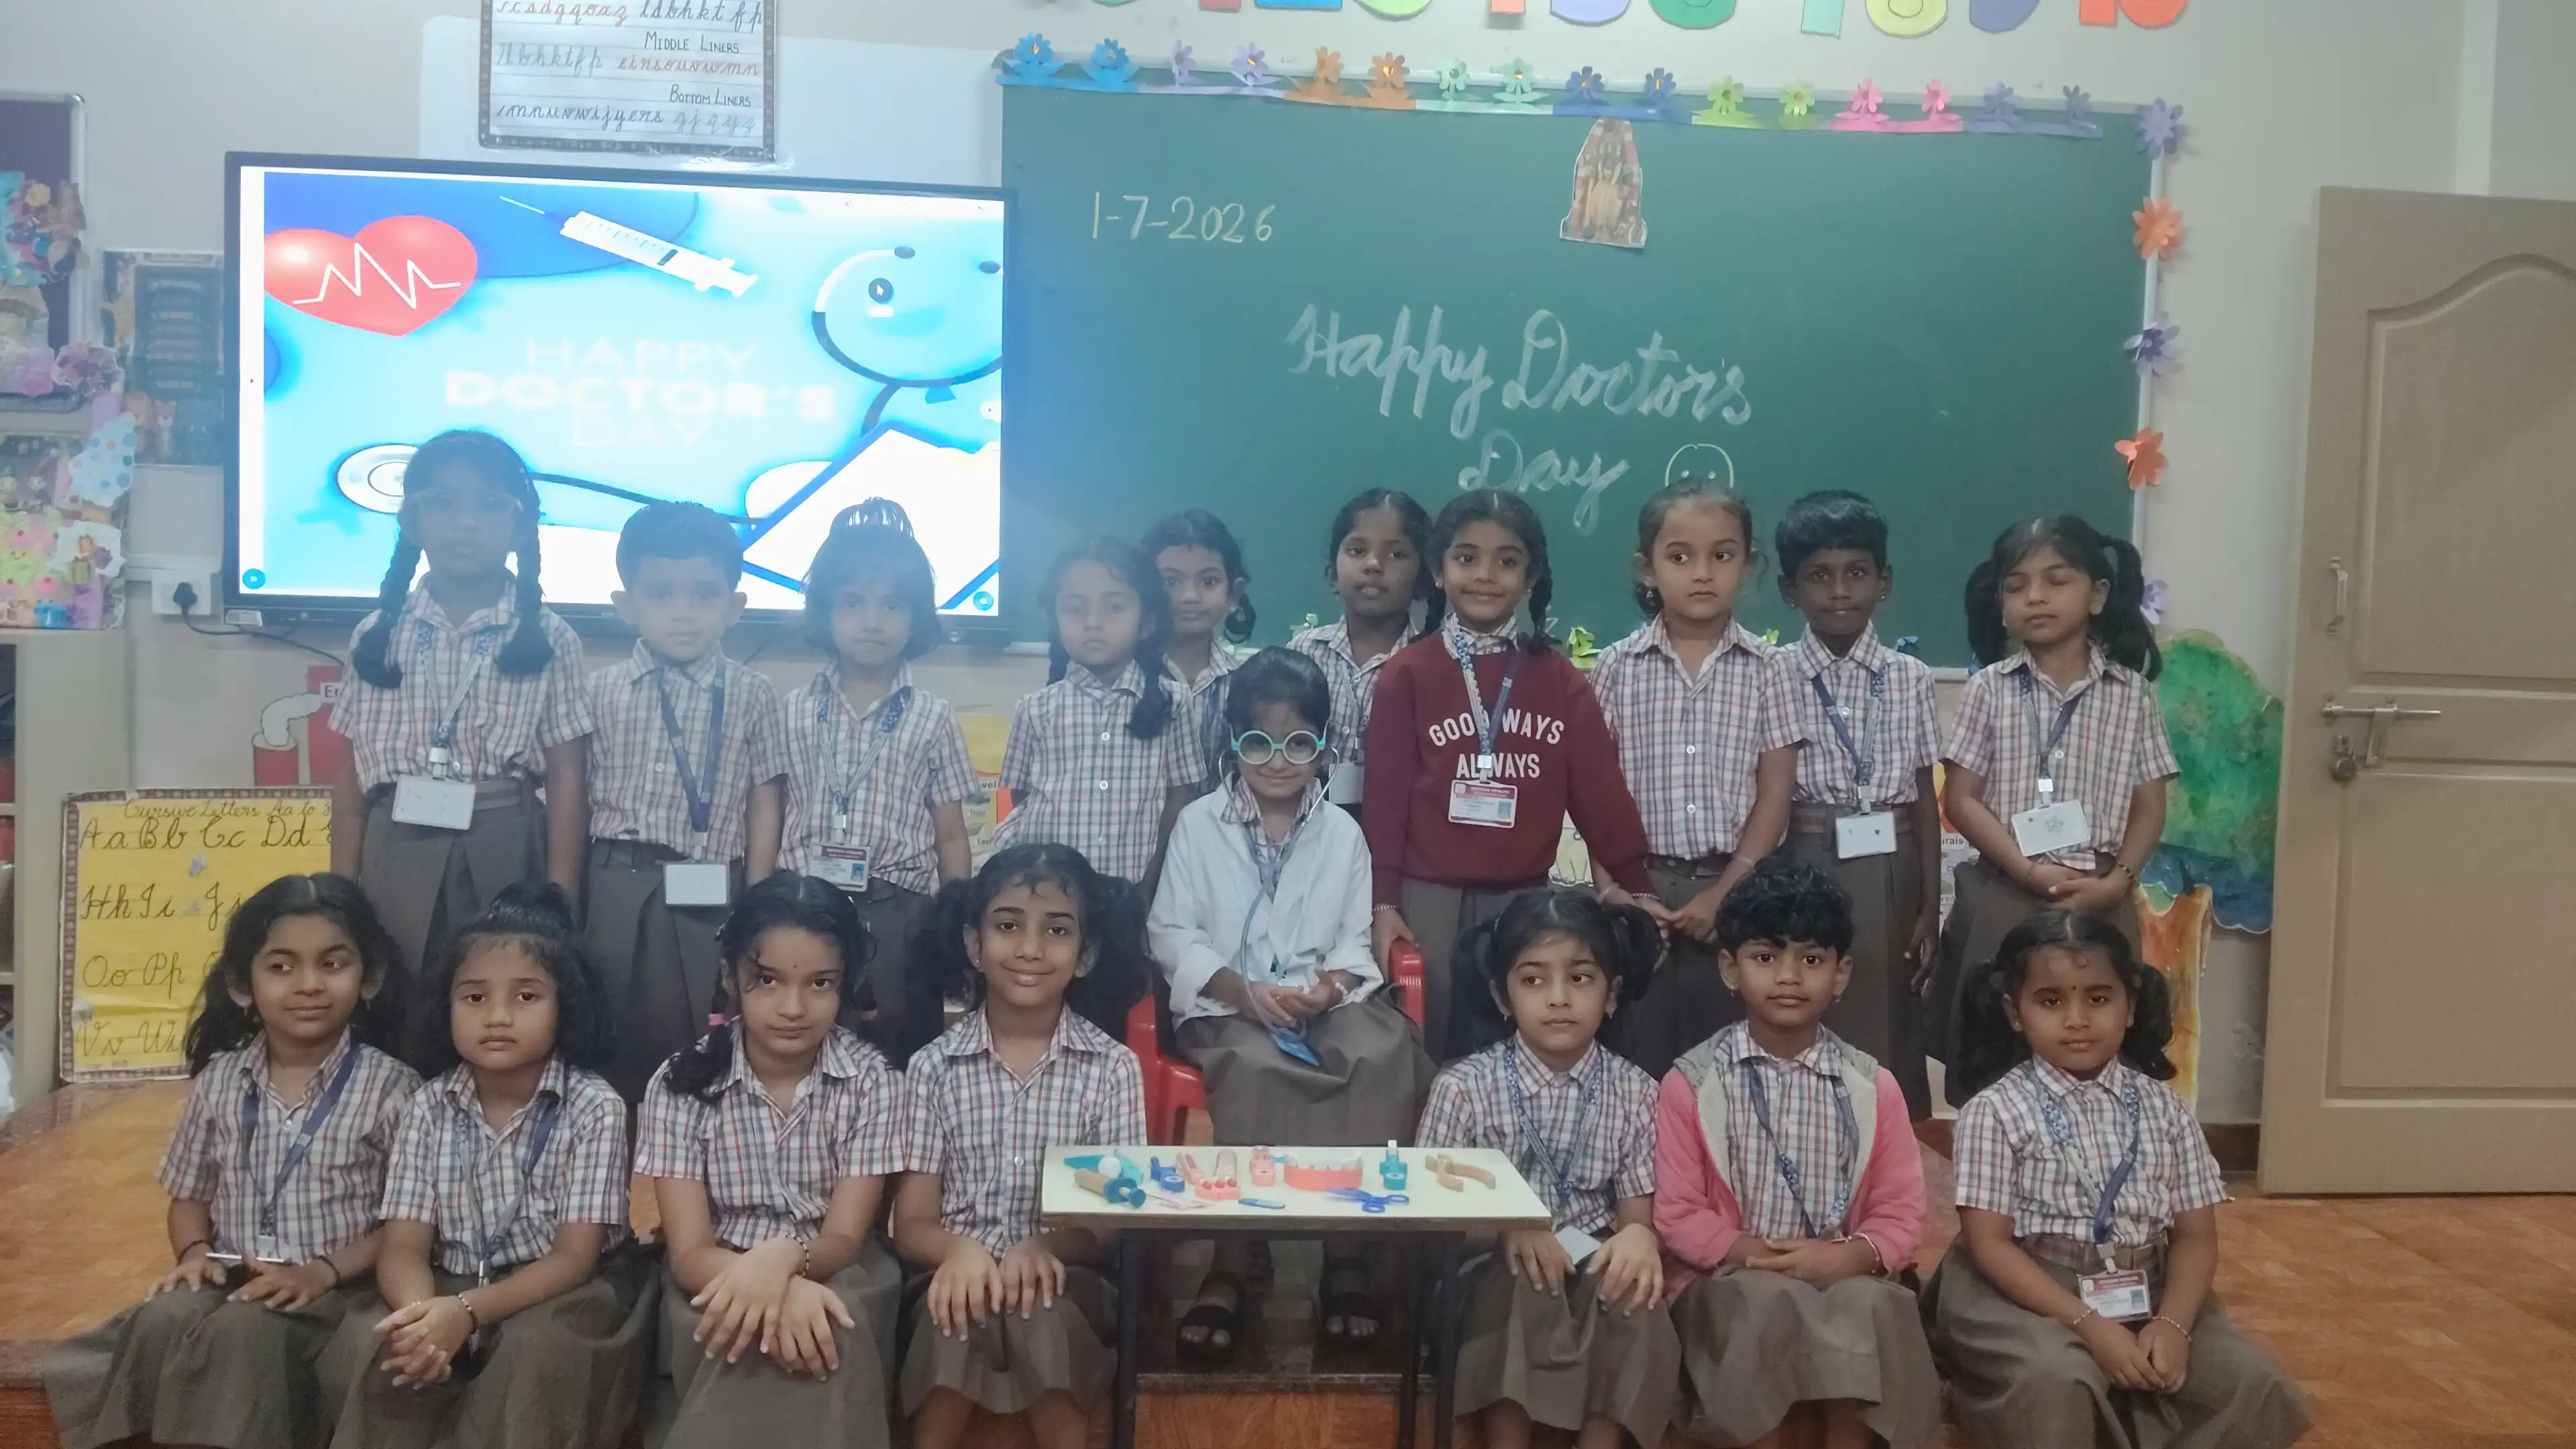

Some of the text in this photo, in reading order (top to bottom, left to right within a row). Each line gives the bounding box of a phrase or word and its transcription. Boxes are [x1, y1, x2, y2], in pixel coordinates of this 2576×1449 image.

[645, 31, 739, 54] MIDDLE LINERS
[669, 84, 751, 107] BOTTOM LINERS
[1093, 191, 1275, 243] 1-7-2026
[527, 335, 757, 375] HAPPY
[1287, 303, 1752, 439] Happy Doctor's
[445, 370, 835, 421] DOCTOR'S
[572, 411, 712, 449] DAY
[1458, 429, 1631, 536] Day
[1429, 708, 1564, 746] GOO WAYS
[124, 798, 197, 818] Cursive
[200, 800, 260, 817] Letters
